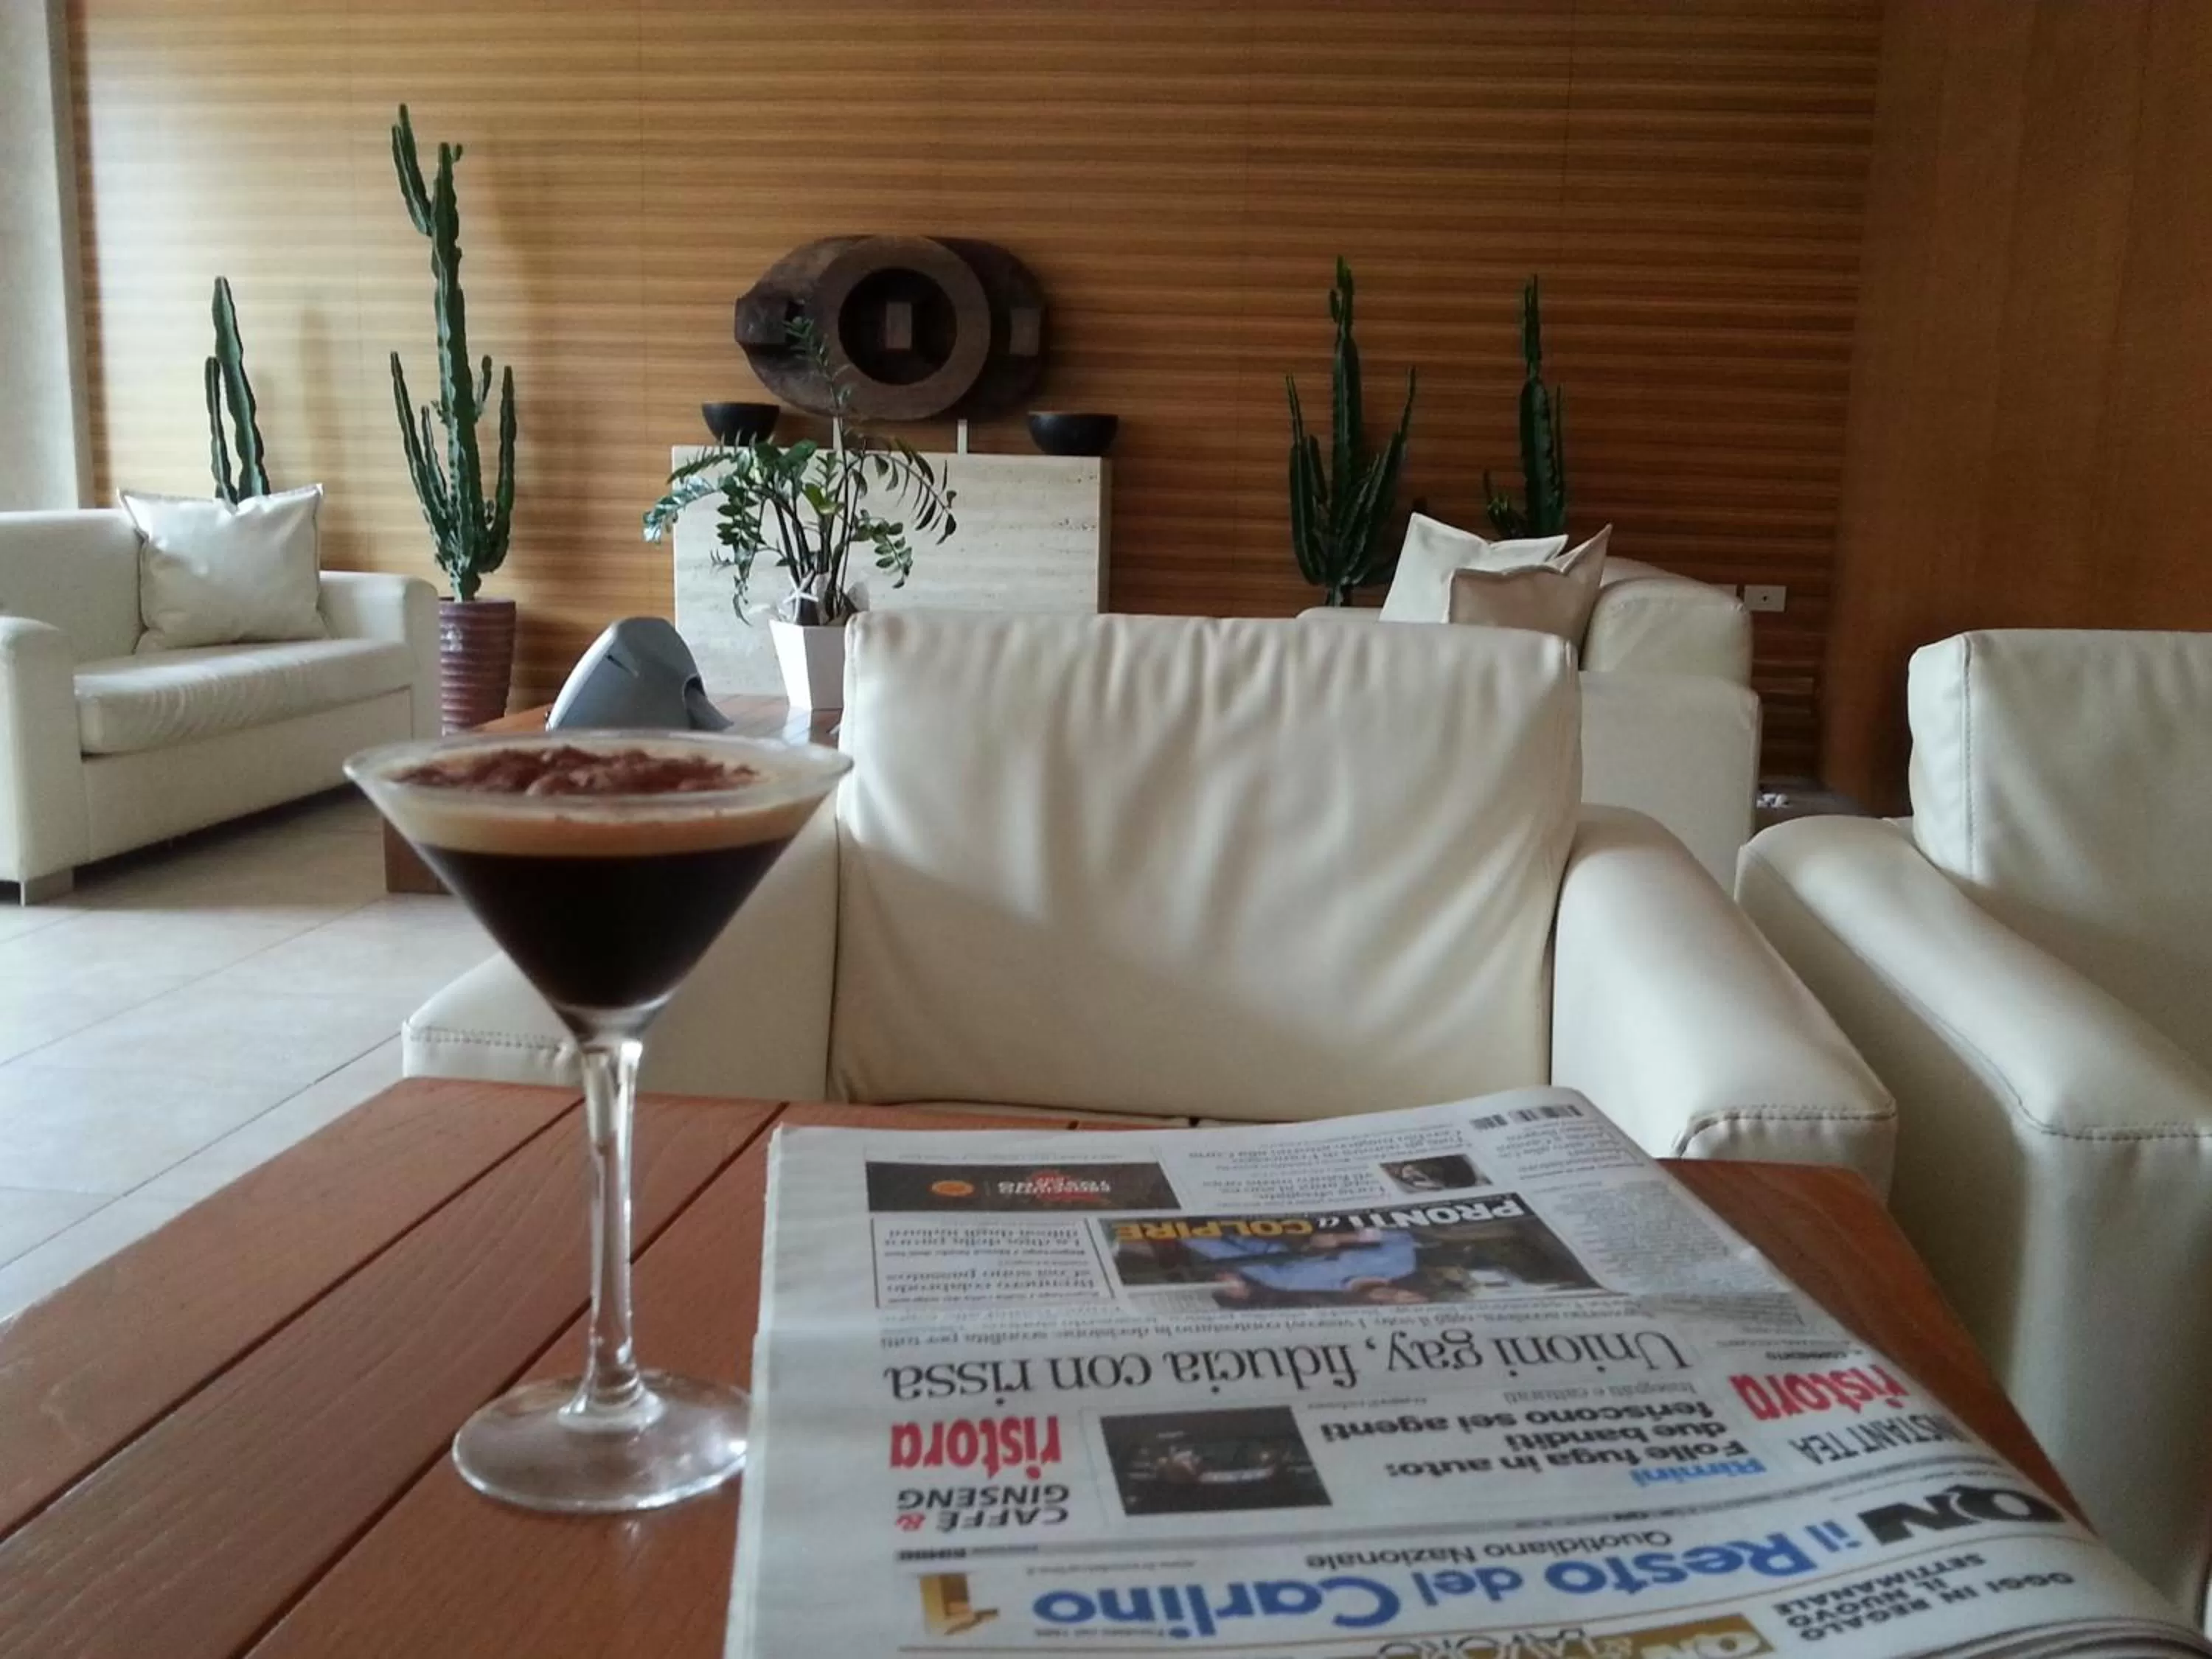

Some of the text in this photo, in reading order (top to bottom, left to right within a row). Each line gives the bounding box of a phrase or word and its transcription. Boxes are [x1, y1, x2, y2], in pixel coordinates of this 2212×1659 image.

[1115, 1219, 1313, 1241] COLPIRE
[1315, 1217, 1340, 1229] a
[1348, 1197, 1524, 1230] PRONTI
[883, 1326, 1688, 1407] Unioni gay, fiducia con rissa
[1728, 1364, 1910, 1422] ristora
[1320, 1399, 1713, 1444] feriscono sei agenti
[1503, 1419, 1727, 1453] due banditi
[888, 1415, 1062, 1481] ristora
[1383, 1438, 1748, 1481] Folle fuga in auto:
[1787, 1430, 1858, 1467] TEA
[1628, 1456, 1767, 1487] Rimini
[897, 1483, 1070, 1510] GINSENG
[1857, 1484, 2065, 1546] QN
[895, 1514, 926, 1533] &
[1804, 1520, 1863, 1554] il
[1304, 1530, 1673, 1573] Quotidiano Nazionale
[1544, 1532, 1818, 1596] Resto
[1410, 1566, 1523, 1607] del
[1772, 1552, 1986, 1617] SETTIMANALE
[1032, 1576, 1401, 1639] Carlino
[1784, 1587, 1910, 1630] NUOVO
[1799, 1572, 2075, 1642] OGGI IN REGALO
